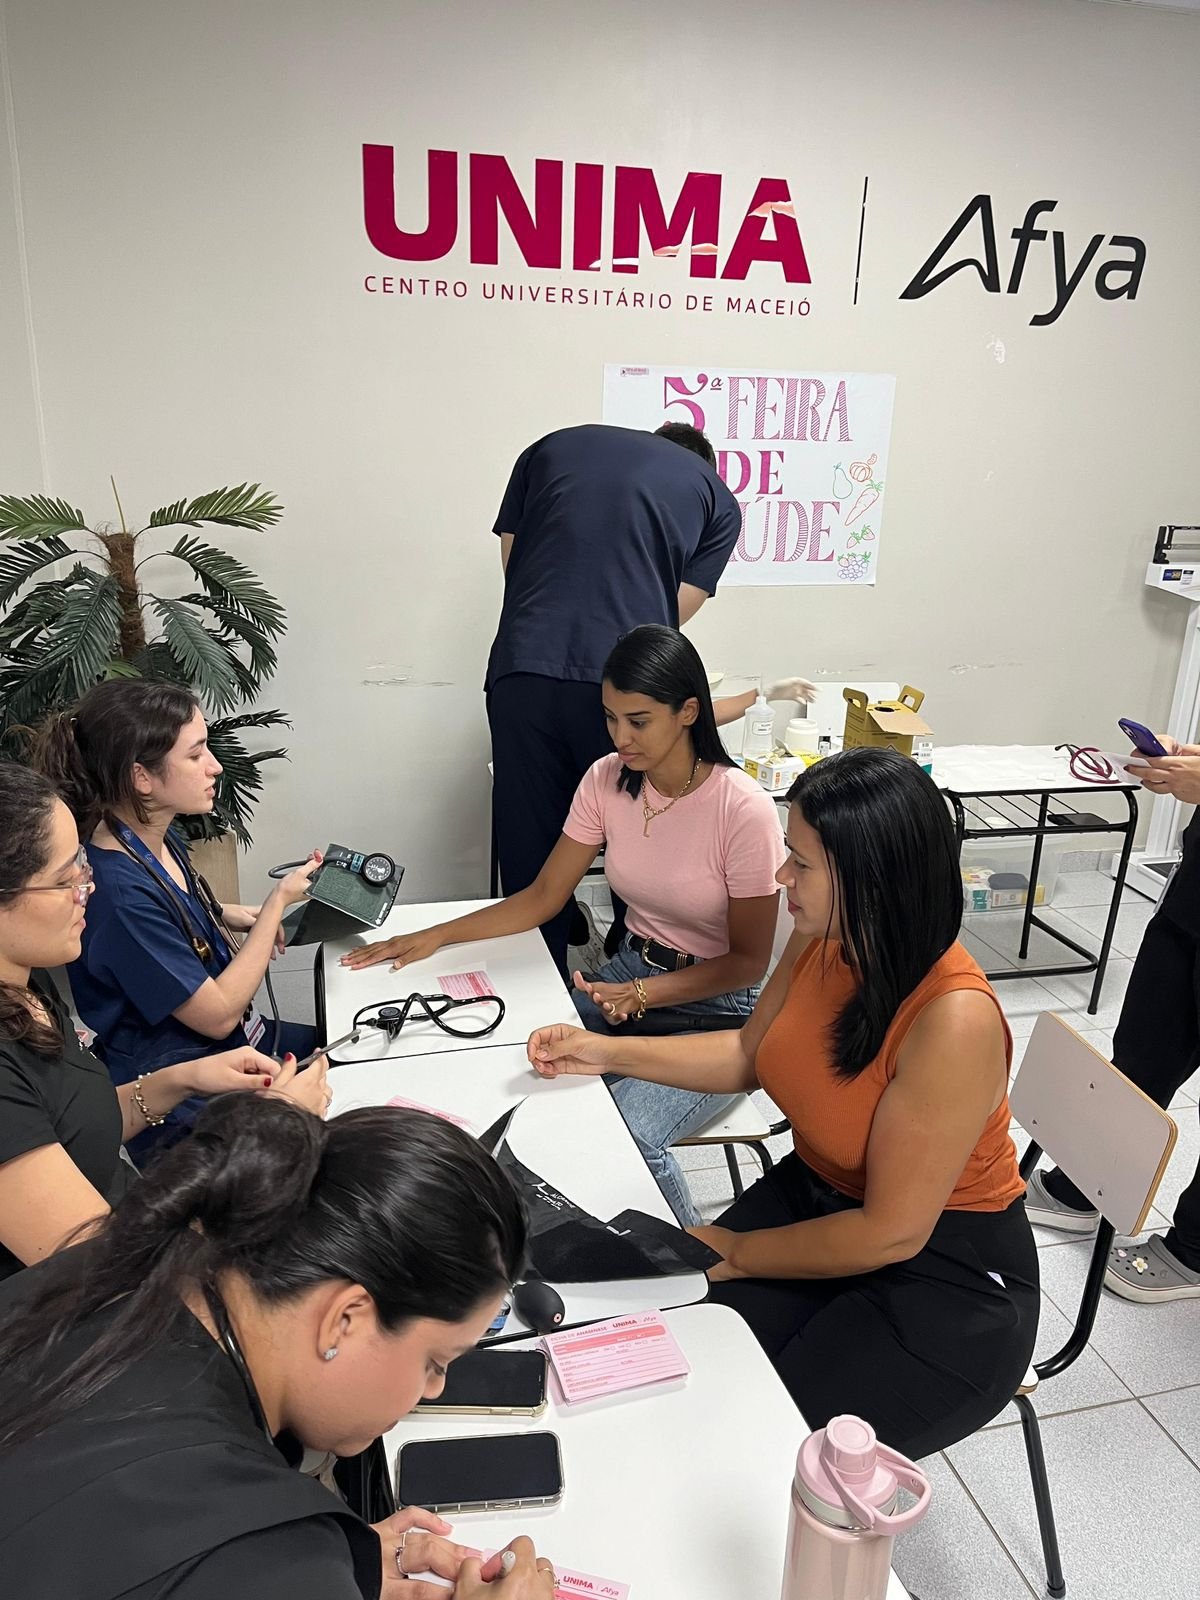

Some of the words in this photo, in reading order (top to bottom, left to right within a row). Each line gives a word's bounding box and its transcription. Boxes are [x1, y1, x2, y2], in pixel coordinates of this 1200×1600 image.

[362, 143, 812, 284] UNIMA
[898, 193, 1148, 326] Afya
[364, 275, 468, 298] CENTRO
[482, 282, 672, 310] UNIVERSITÁRIO
[685, 294, 714, 312] DE
[726, 297, 812, 317] MACEIÓ
[723, 376, 854, 442] FEIRA
[715, 450, 784, 495] DE
[729, 496, 840, 562] ÚDE
[612, 1318, 638, 1329] UNIMA
[563, 1575, 594, 1590] UNIMA
[600, 1586, 620, 1597] Afya
